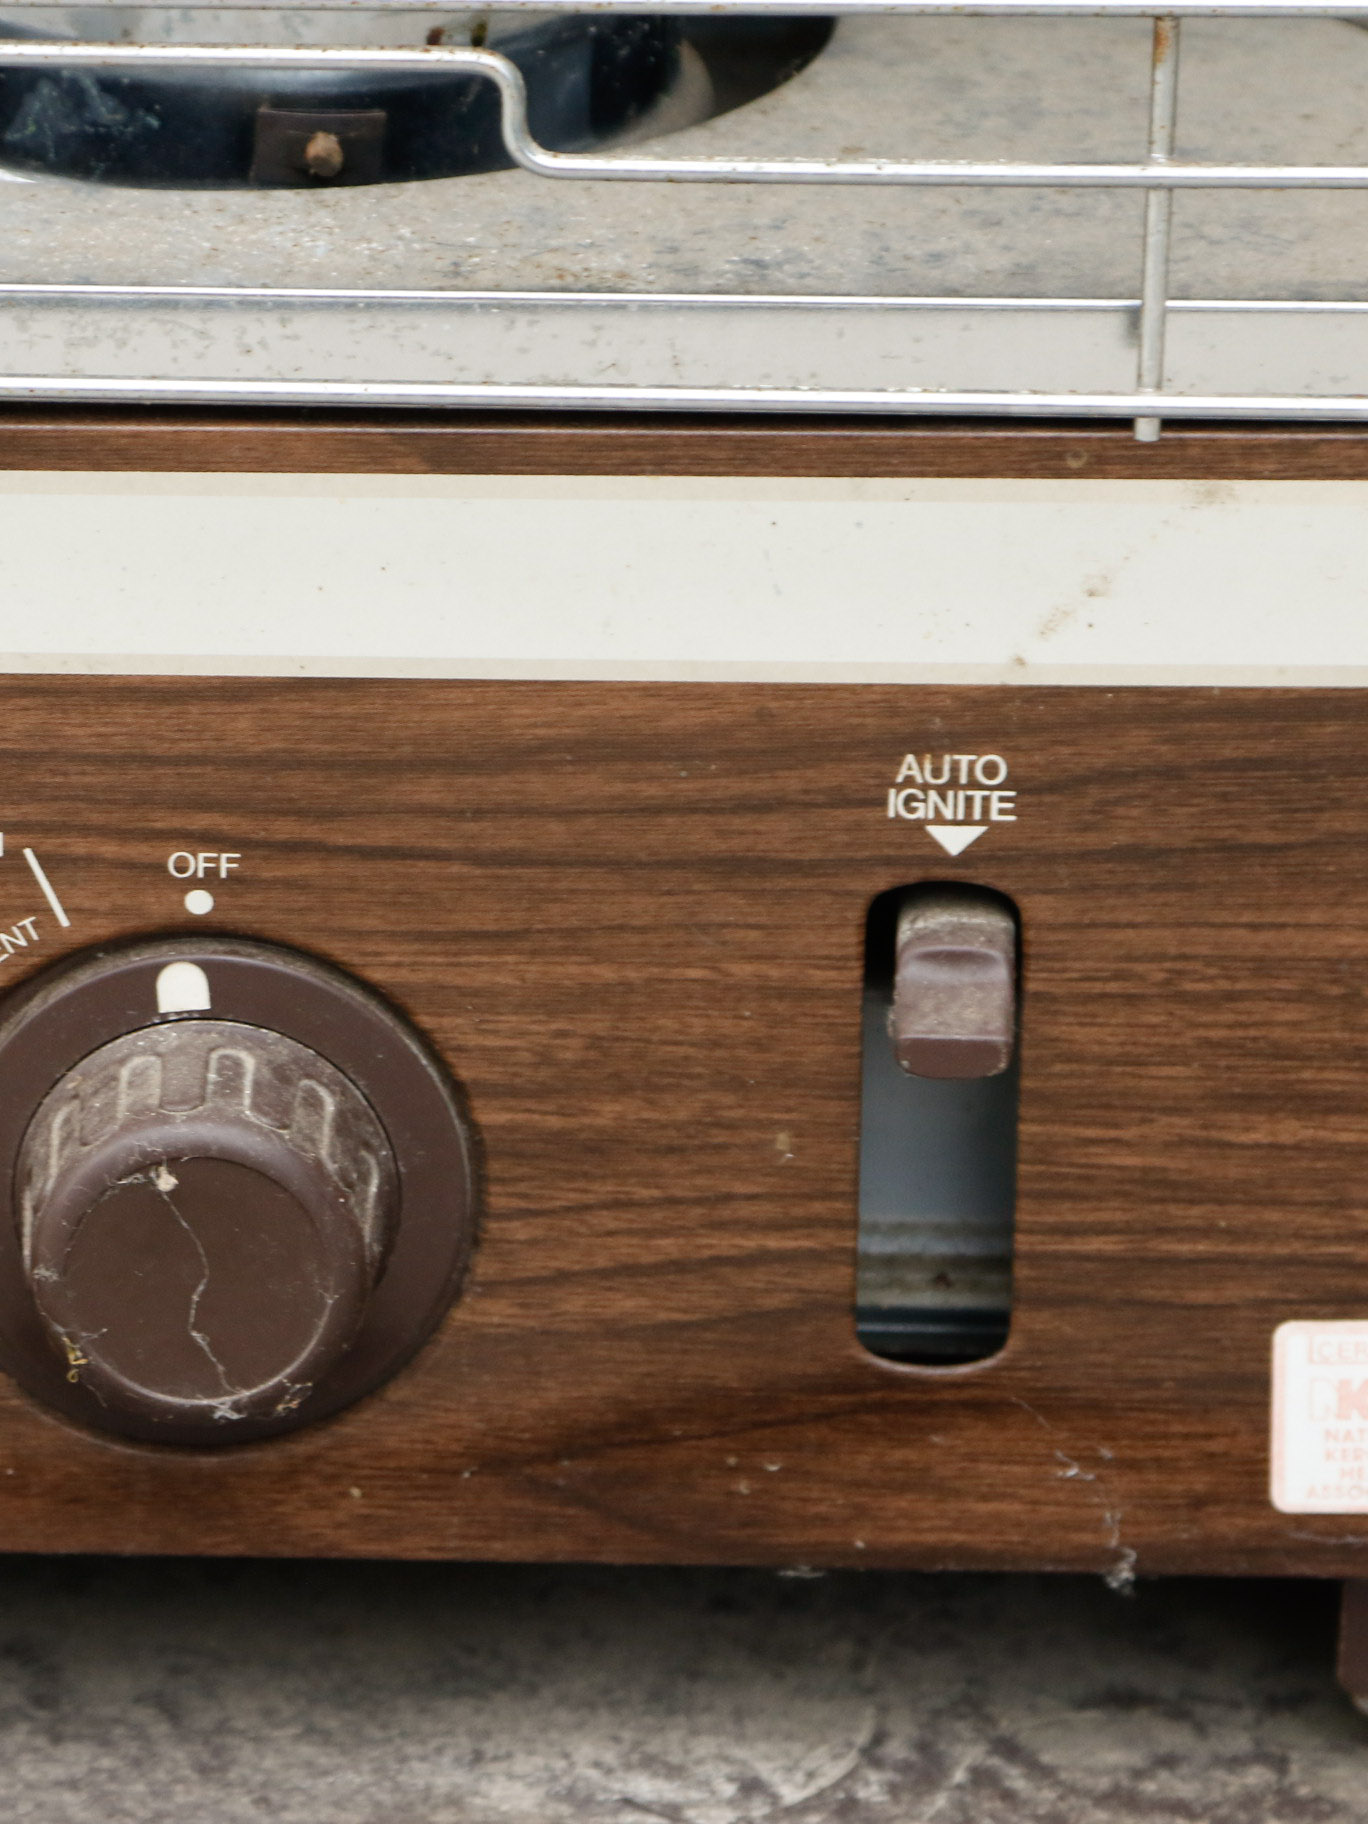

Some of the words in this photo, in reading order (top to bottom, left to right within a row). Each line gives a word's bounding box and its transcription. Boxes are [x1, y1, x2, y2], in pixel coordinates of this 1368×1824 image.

[894, 754, 1008, 786] AUTO
[887, 788, 1018, 821] IGNITE
[167, 852, 242, 879] OFF
